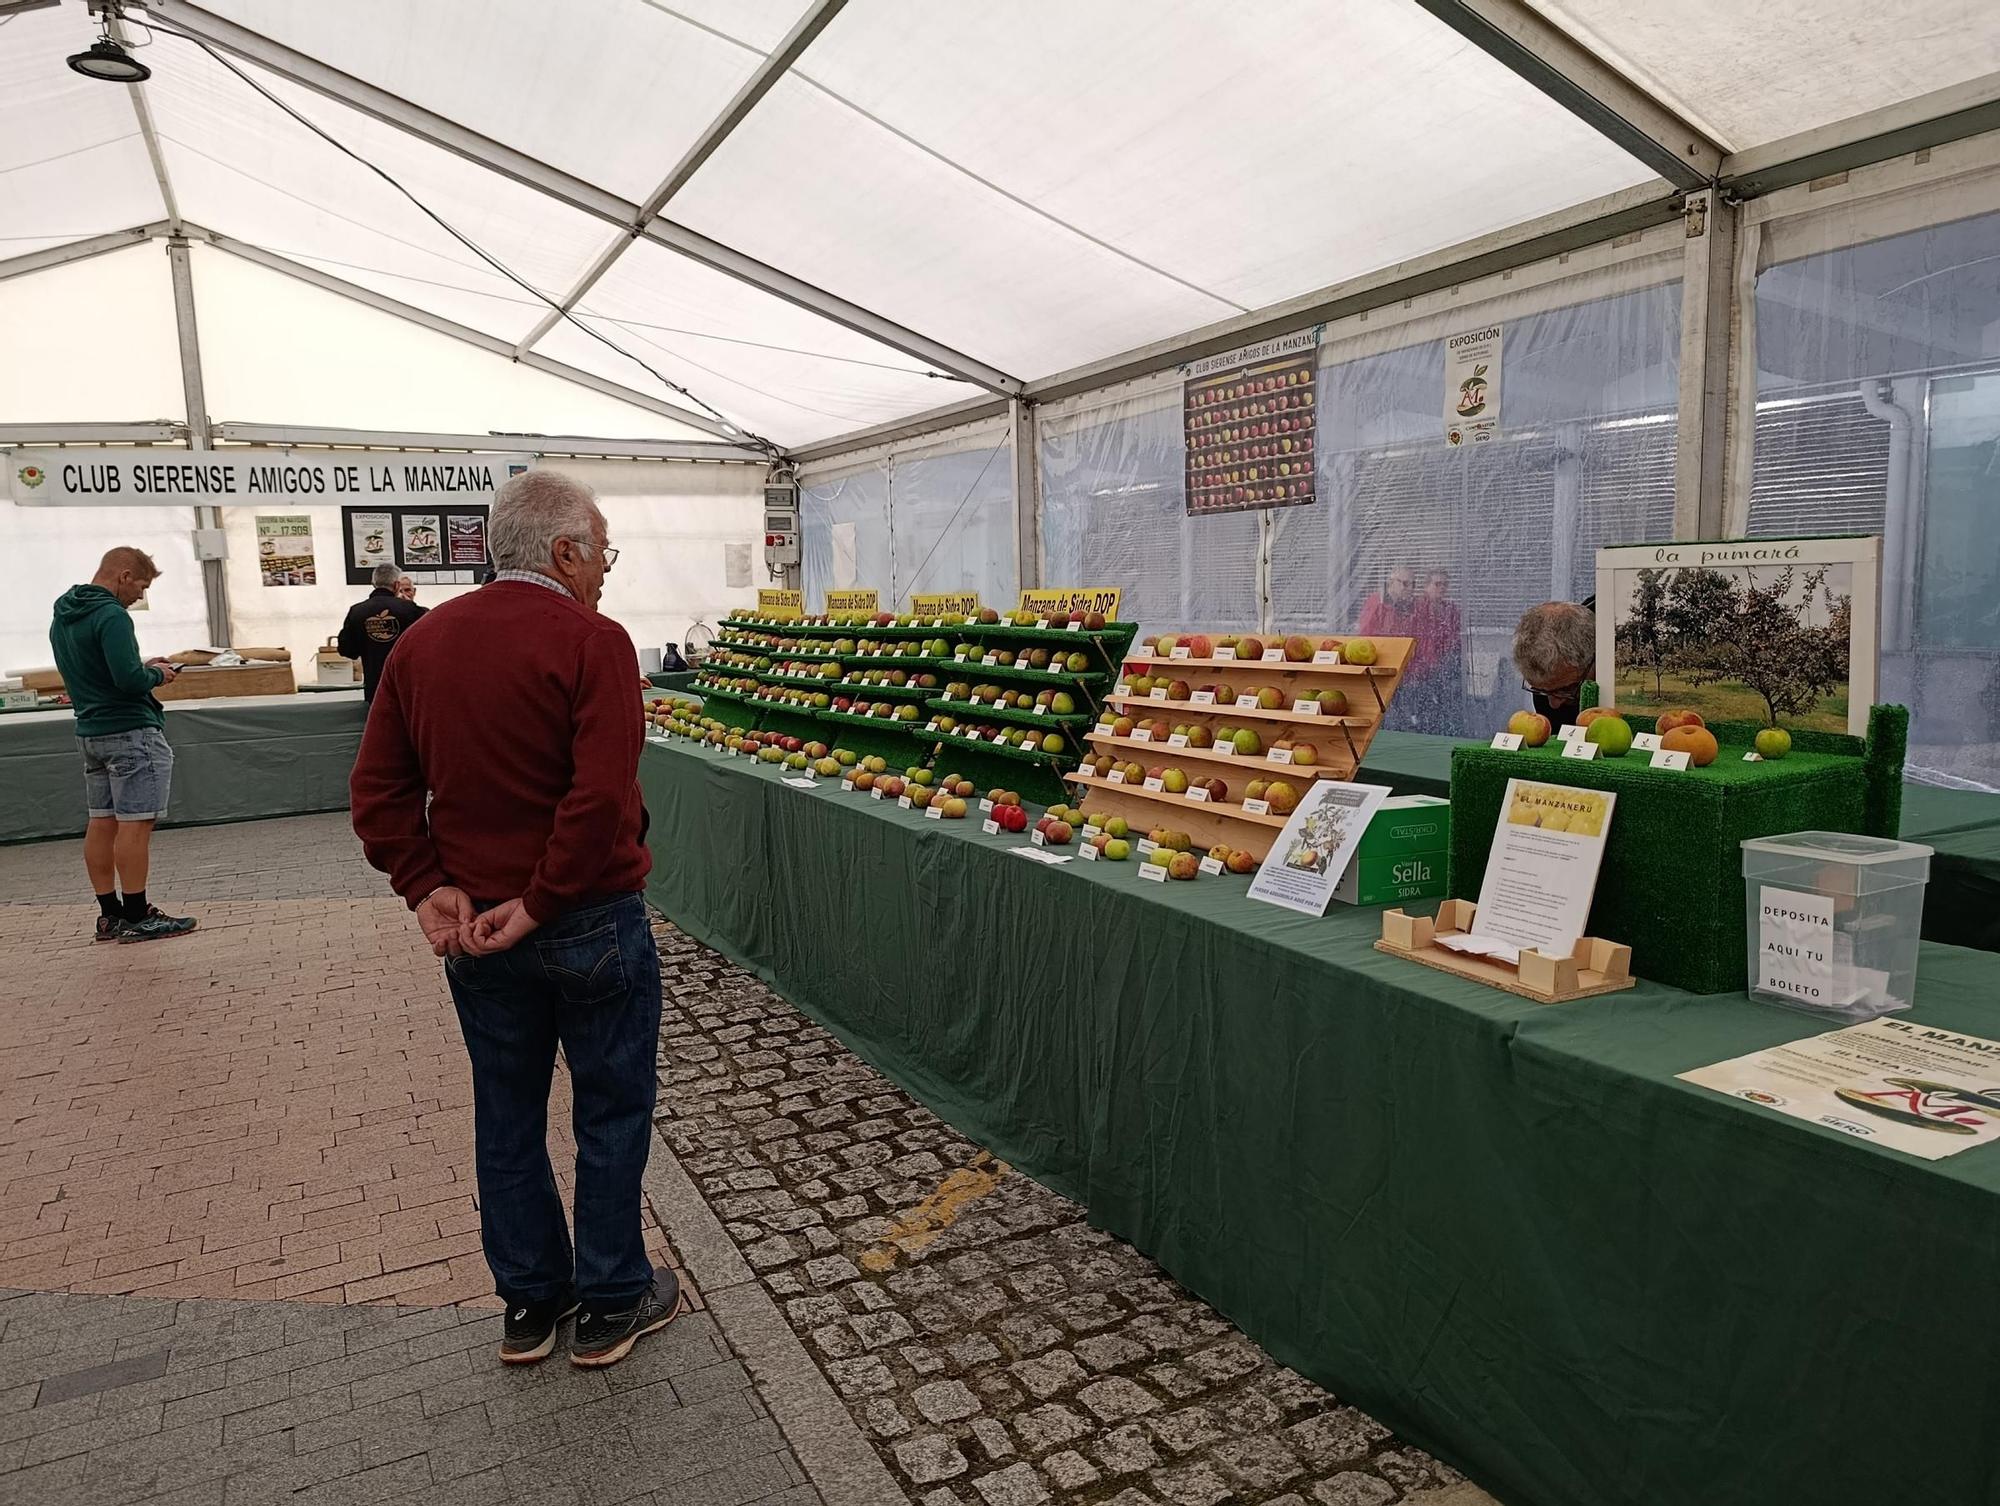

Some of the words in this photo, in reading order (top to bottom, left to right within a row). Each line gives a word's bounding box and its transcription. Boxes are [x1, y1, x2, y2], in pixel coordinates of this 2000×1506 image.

[1449, 327, 1500, 349] EXPOSICIÓN
[1195, 362, 1210, 373] CLUB
[1210, 353, 1236, 370] SIERENSE
[1239, 346, 1260, 362] AMIGOS
[1261, 344, 1270, 356] DE
[1271, 342, 1281, 353] LA
[63, 464, 121, 493] CLUB
[133, 465, 237, 493] SIERENSE
[248, 466, 326, 494] AMIGOS
[334, 466, 360, 493] DE
[370, 466, 396, 493] LA
[404, 466, 495, 492] MANZANA
[1655, 547, 1680, 563] la
[1701, 545, 1800, 565] pumará
[827, 593, 847, 609] Manzana
[848, 594, 854, 610] de
[854, 593, 866, 610] Sidra
[866, 593, 875, 609] DOP
[913, 599, 937, 615] Manzana
[937, 599, 944, 616] de
[945, 598, 961, 615] Sidra
[961, 597, 975, 616] DOP
[1023, 594, 1056, 614] Manzana
[1057, 594, 1067, 613] de
[1069, 593, 1092, 614] Sidra
[1094, 593, 1116, 614] DOP
[1576, 745, 1583, 753] 5
[1664, 754, 1673, 763] 6
[1535, 798, 1593, 814] MANZANERU
[1392, 861, 1431, 884] Sella
[1398, 887, 1422, 898] SIDRA
[1764, 906, 1829, 926] DEPOSITA
[1768, 942, 1799, 957] AQUI
[1806, 950, 1823, 961] TU
[1769, 978, 1820, 998] BOLETO
[1882, 1021, 1914, 1034] EL
[1855, 1054, 1901, 1070] VOTA
[1818, 1116, 1870, 1136] SIERO
